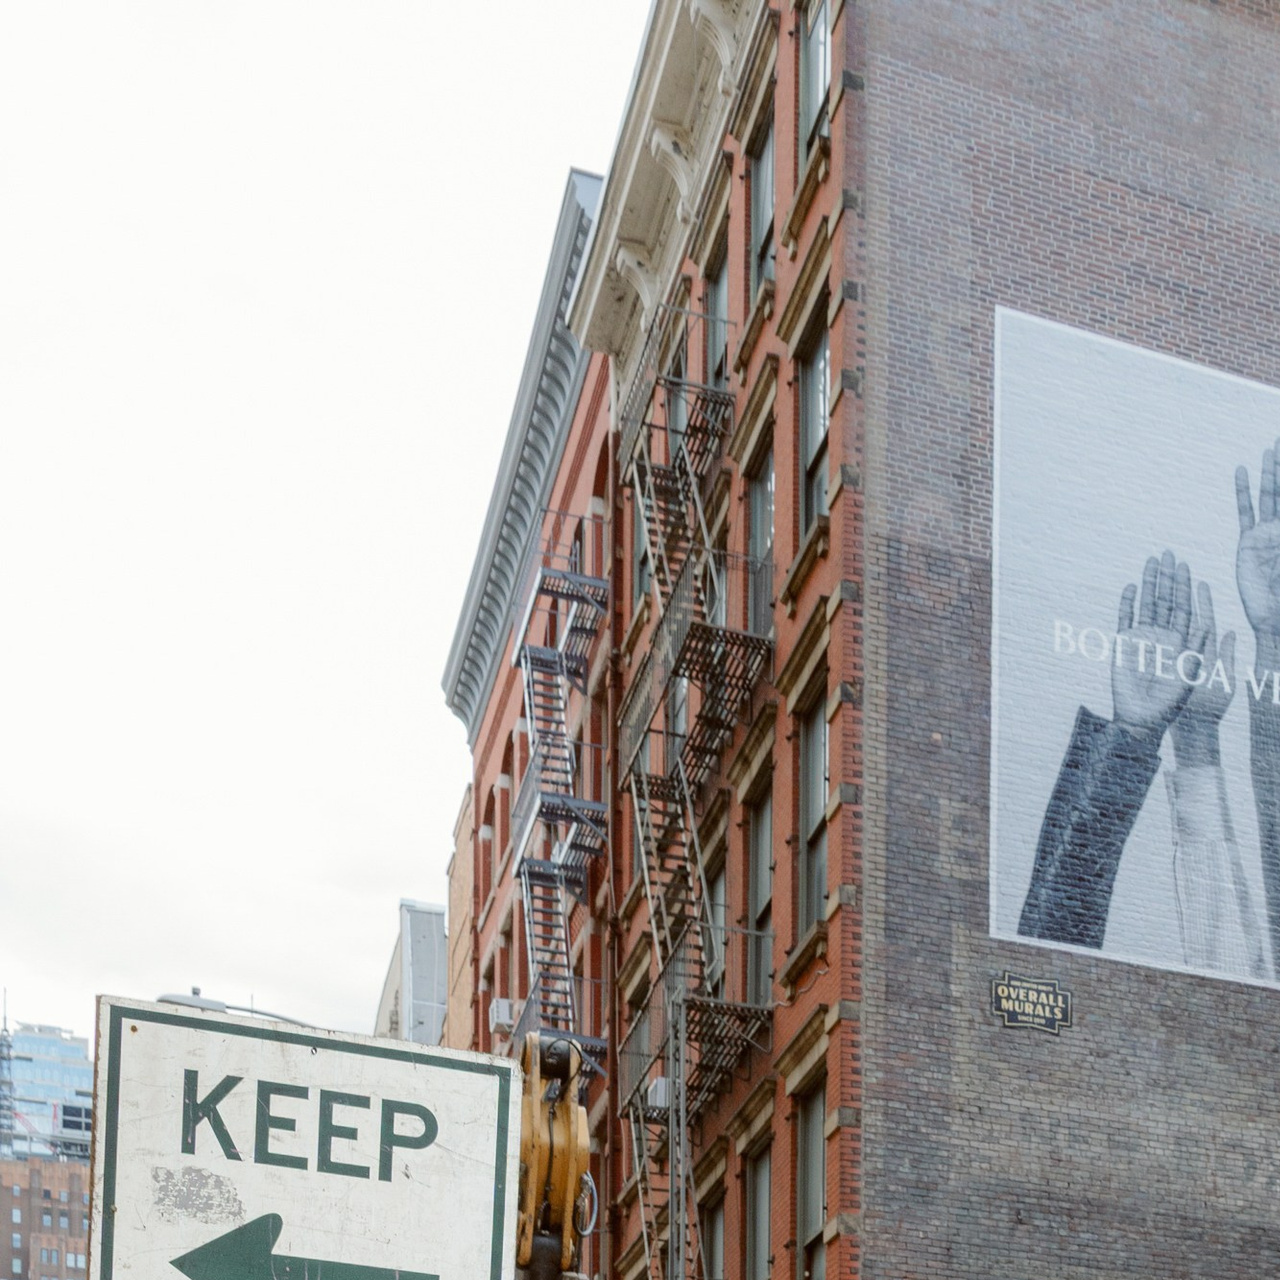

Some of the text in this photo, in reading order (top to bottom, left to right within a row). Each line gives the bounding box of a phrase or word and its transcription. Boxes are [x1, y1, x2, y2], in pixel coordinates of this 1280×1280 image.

[1053, 620, 1231, 693] BOTTEGA
[997, 985, 1065, 1008] OVERALL
[1001, 998, 1063, 1020] MURALS
[182, 1068, 439, 1182] KEEP
